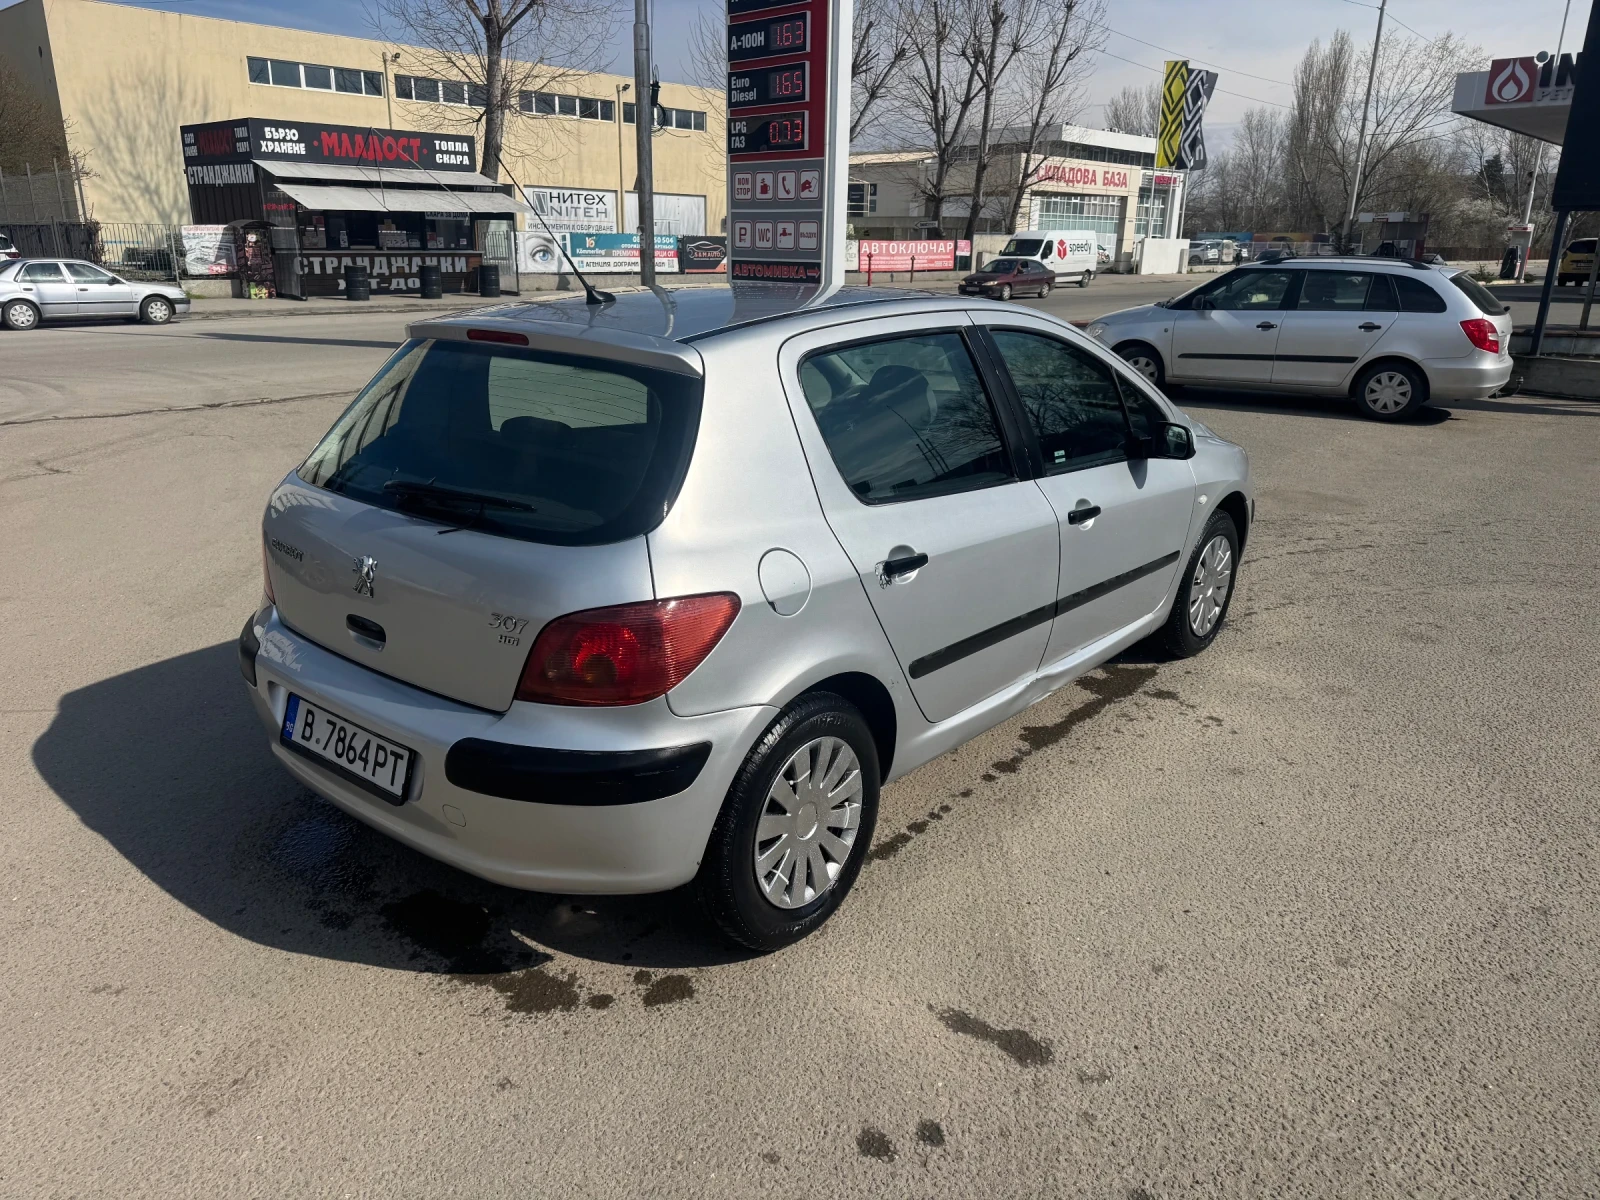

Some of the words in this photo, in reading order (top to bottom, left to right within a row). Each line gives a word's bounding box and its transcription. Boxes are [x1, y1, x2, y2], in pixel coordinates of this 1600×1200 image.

[731, 76, 750, 89] Euro
[731, 88, 757, 103] Diesel
[264, 127, 299, 140] БЪРЗО
[731, 121, 747, 134] LPG
[260, 140, 306, 155] ХРАНЕНЕ
[320, 131, 421, 162] МЛАДОСТ
[434, 140, 469, 152] ТОПЛА
[731, 136, 746, 149] ГАЗ
[435, 153, 470, 165] СКАРА
[187, 163, 255, 187] СТРАНДЖАНКИ
[1036, 164, 1097, 187] СКЛАДОВА
[1102, 172, 1128, 188] БАЗА
[738, 178, 750, 186] NON
[736, 187, 751, 196] STOP
[550, 205, 608, 218] NITEH
[758, 228, 770, 242] WC
[861, 242, 954, 254] АВТОКЛЮЧАР
[1069, 240, 1092, 255] speedy
[733, 263, 807, 279] АВТОМИВКА
[488, 612, 529, 634] 307
